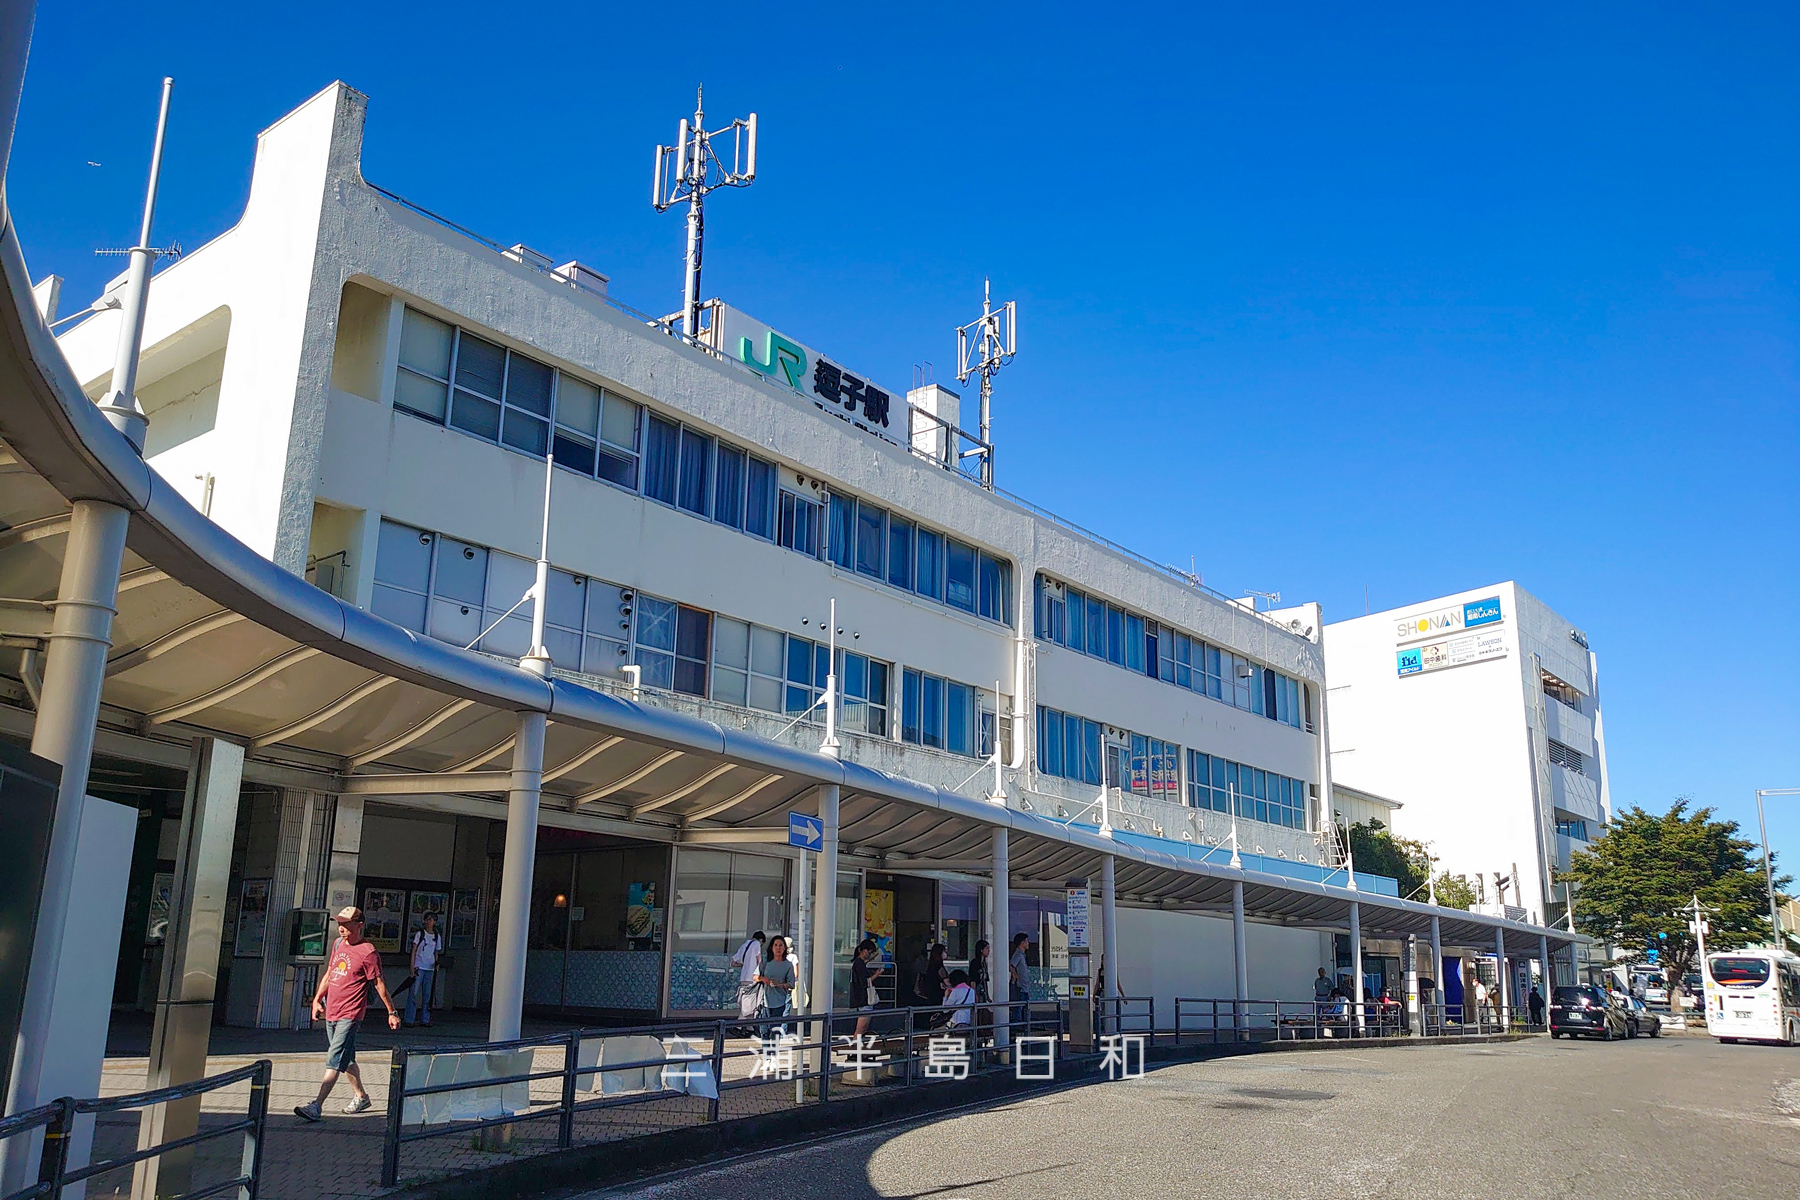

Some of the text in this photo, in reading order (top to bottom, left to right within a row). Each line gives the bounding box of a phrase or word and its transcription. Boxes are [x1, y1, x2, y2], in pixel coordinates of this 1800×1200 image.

[740, 331, 807, 395] JR
[813, 357, 890, 429] 逗子駅
[1397, 610, 1462, 637] SHONAN
[1424, 654, 1447, 664] 田中歯科
